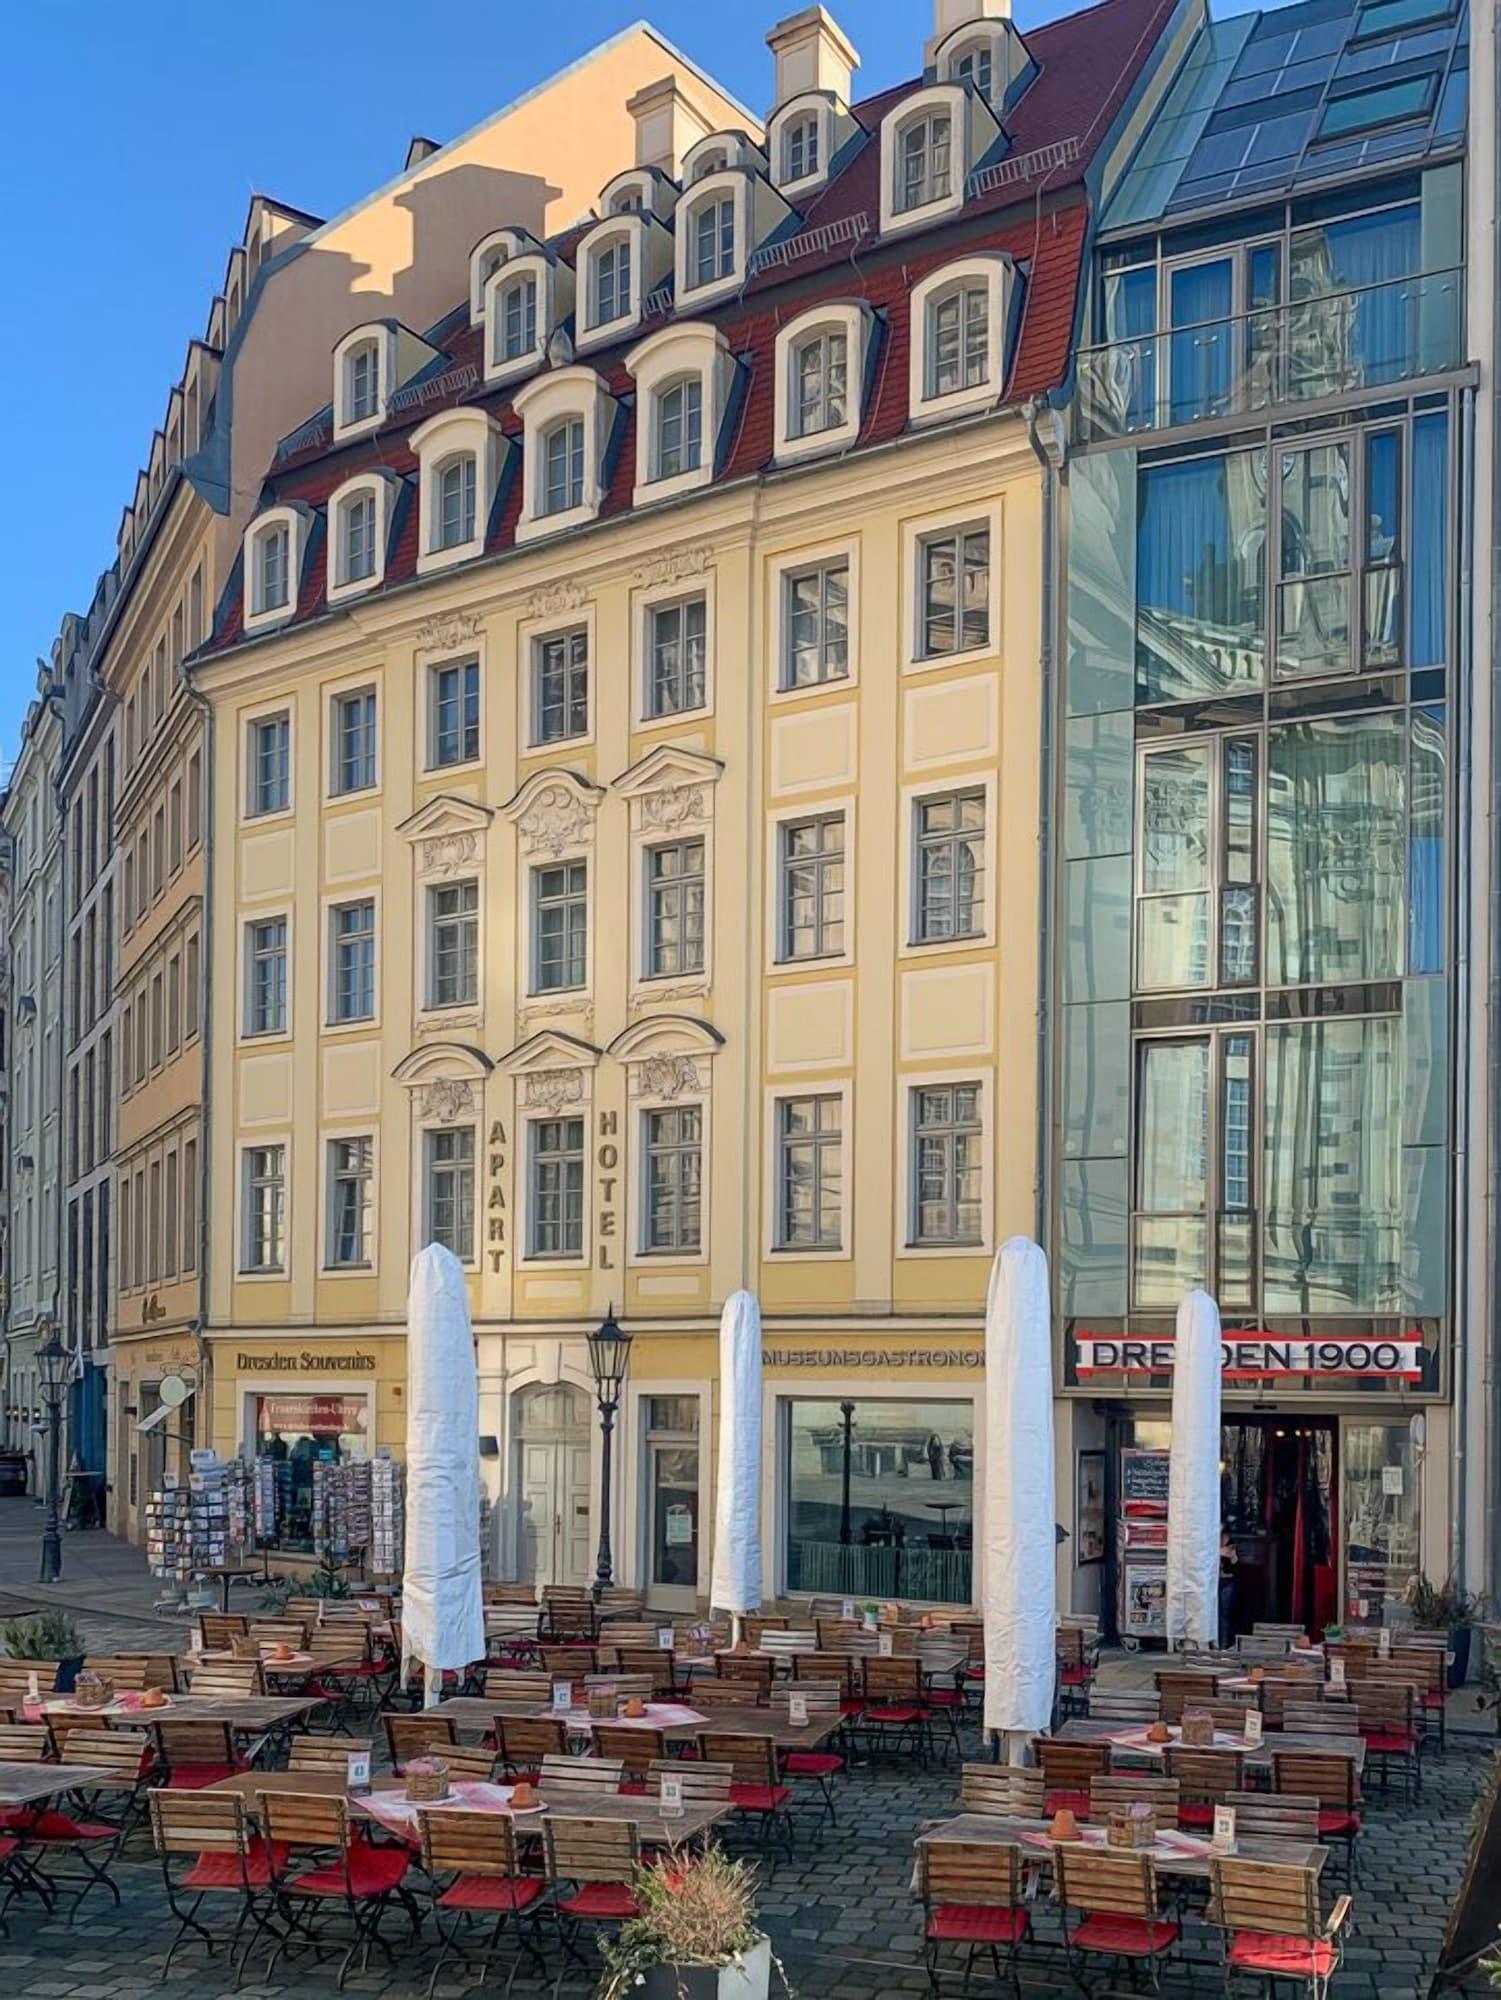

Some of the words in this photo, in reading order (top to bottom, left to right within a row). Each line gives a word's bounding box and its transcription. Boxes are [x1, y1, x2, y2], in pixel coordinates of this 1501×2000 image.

[488, 1120, 506, 1273] APART
[598, 1111, 617, 1269] HOTEL
[237, 1352, 297, 1370] Dresden
[300, 1350, 376, 1370] Souvenirs
[1093, 1342, 1290, 1370] DREEN
[1305, 1342, 1400, 1370] 1900
